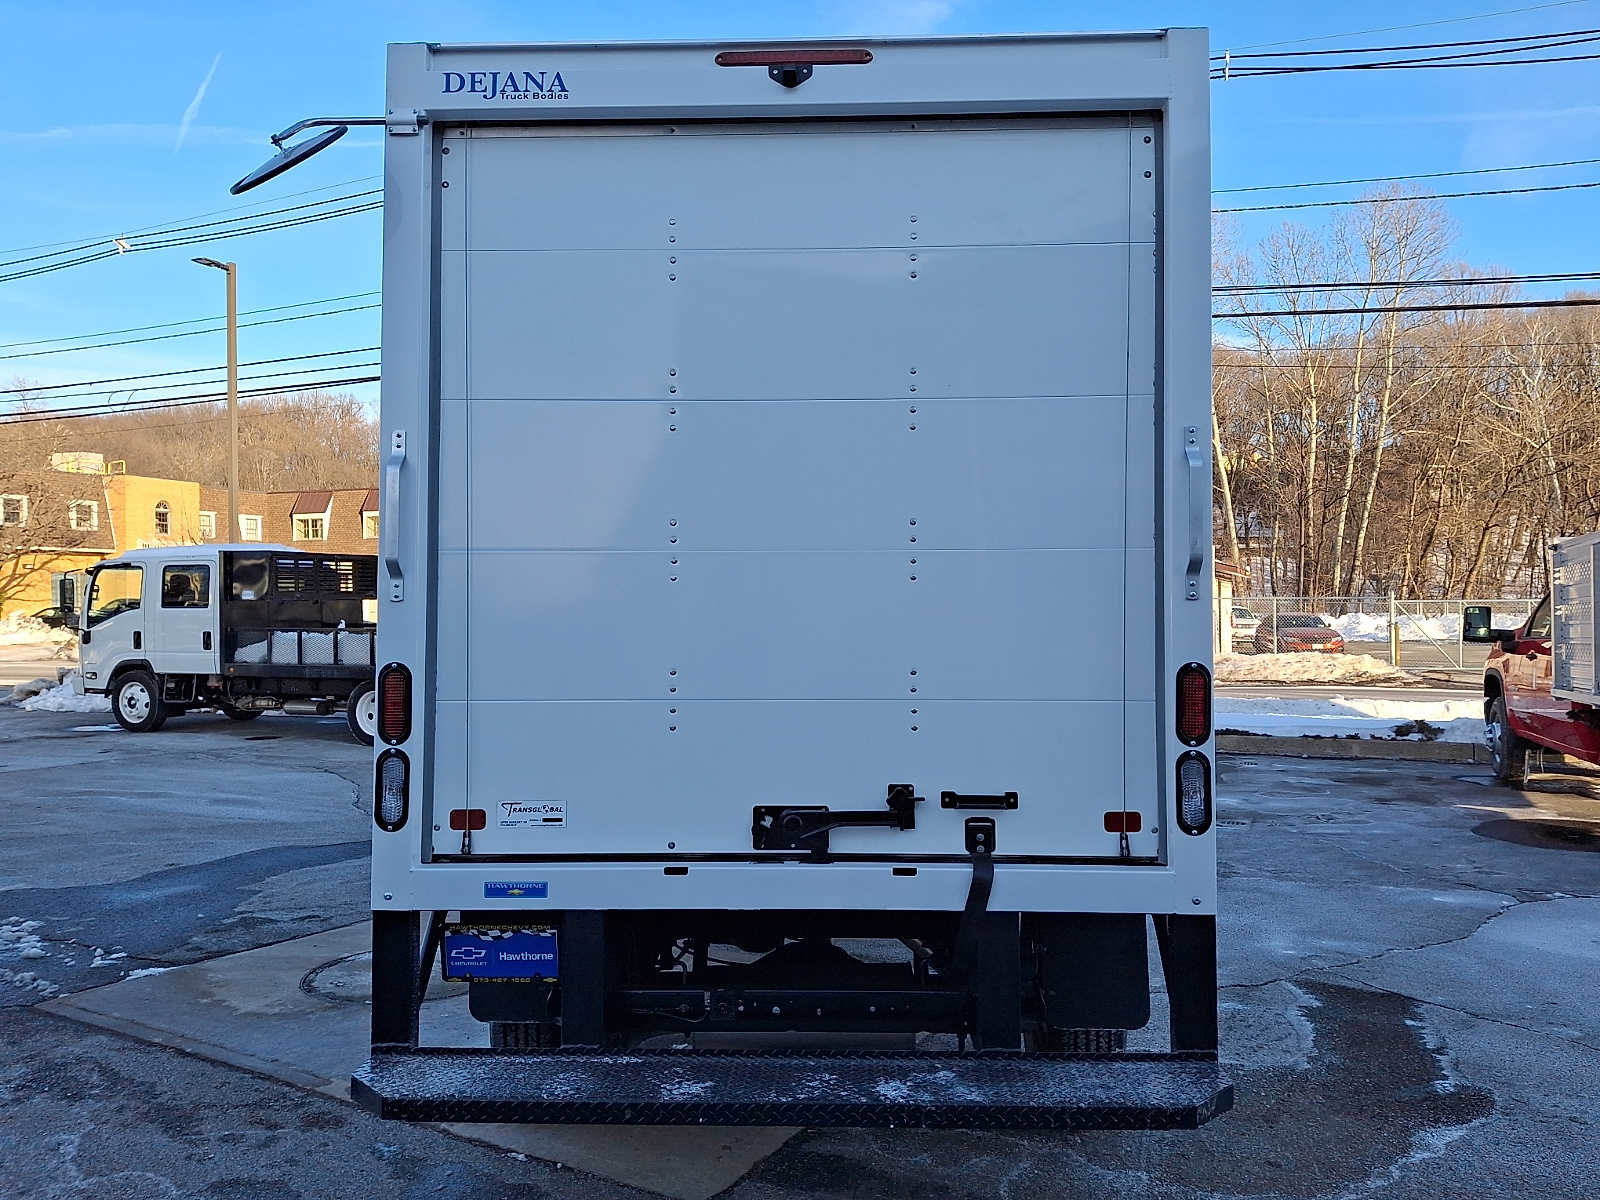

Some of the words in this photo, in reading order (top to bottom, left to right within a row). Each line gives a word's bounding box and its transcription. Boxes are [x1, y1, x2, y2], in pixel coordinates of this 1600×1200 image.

[441, 71, 569, 100] DEJANA
[499, 92, 529, 100] Truck
[532, 92, 569, 100] Bodies
[499, 951, 553, 961] Hawthorne
